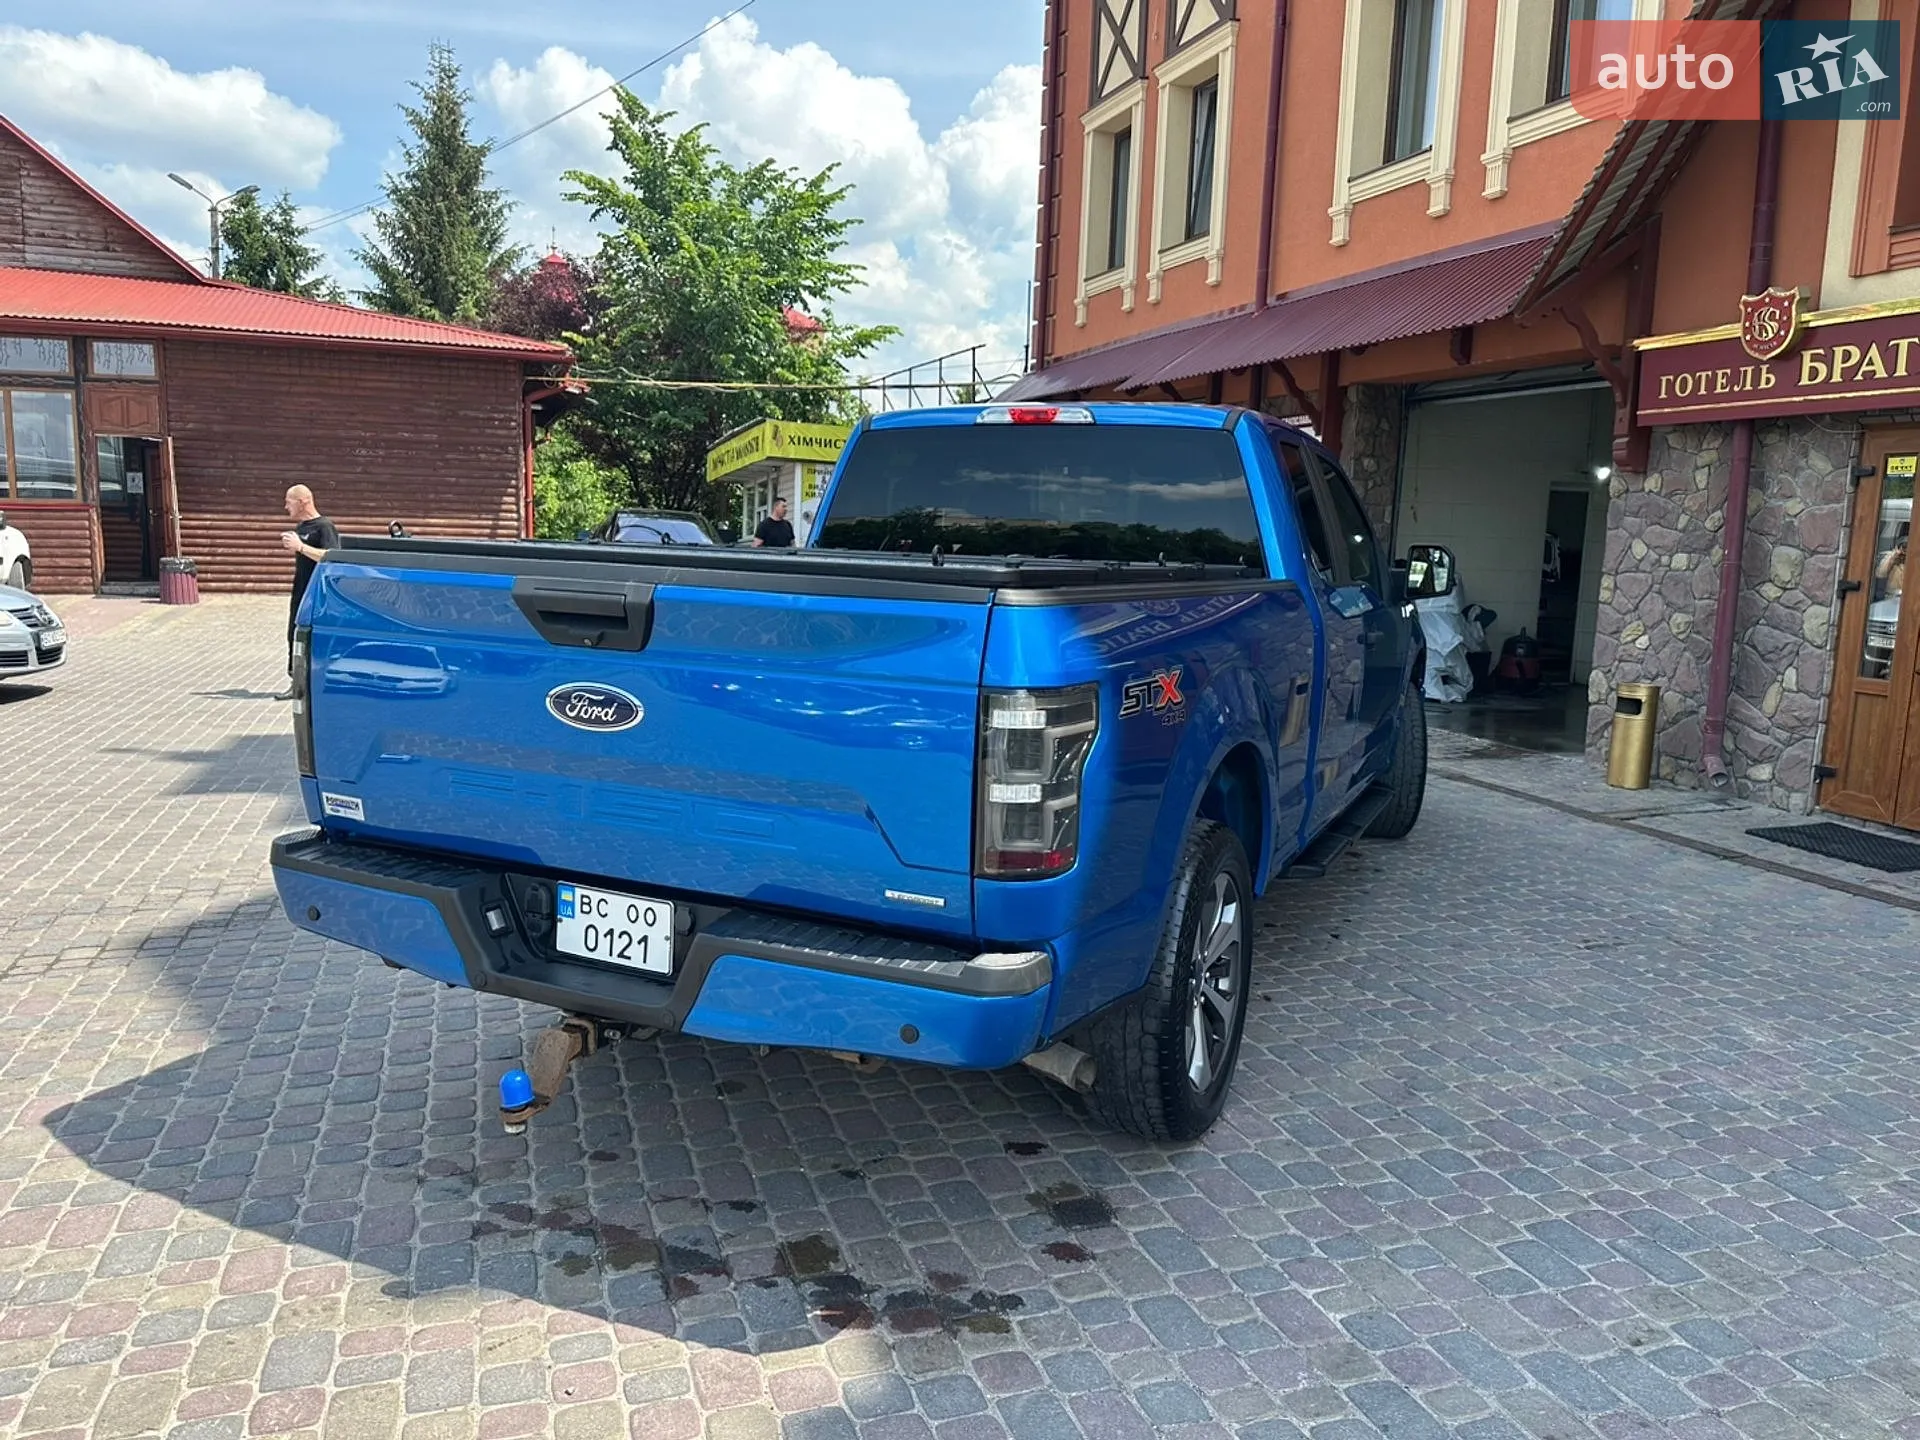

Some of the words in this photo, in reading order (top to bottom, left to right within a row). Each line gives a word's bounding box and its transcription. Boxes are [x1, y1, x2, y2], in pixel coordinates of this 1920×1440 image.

[1658, 363, 1777, 399] ГОТЕЛЬ
[1798, 336, 1920, 386] БРАТ
[565, 691, 618, 721] Ford
[1119, 668, 1184, 719] STX
[560, 903, 573, 916] UA
[580, 894, 609, 918] BC
[584, 924, 649, 964] 0121
